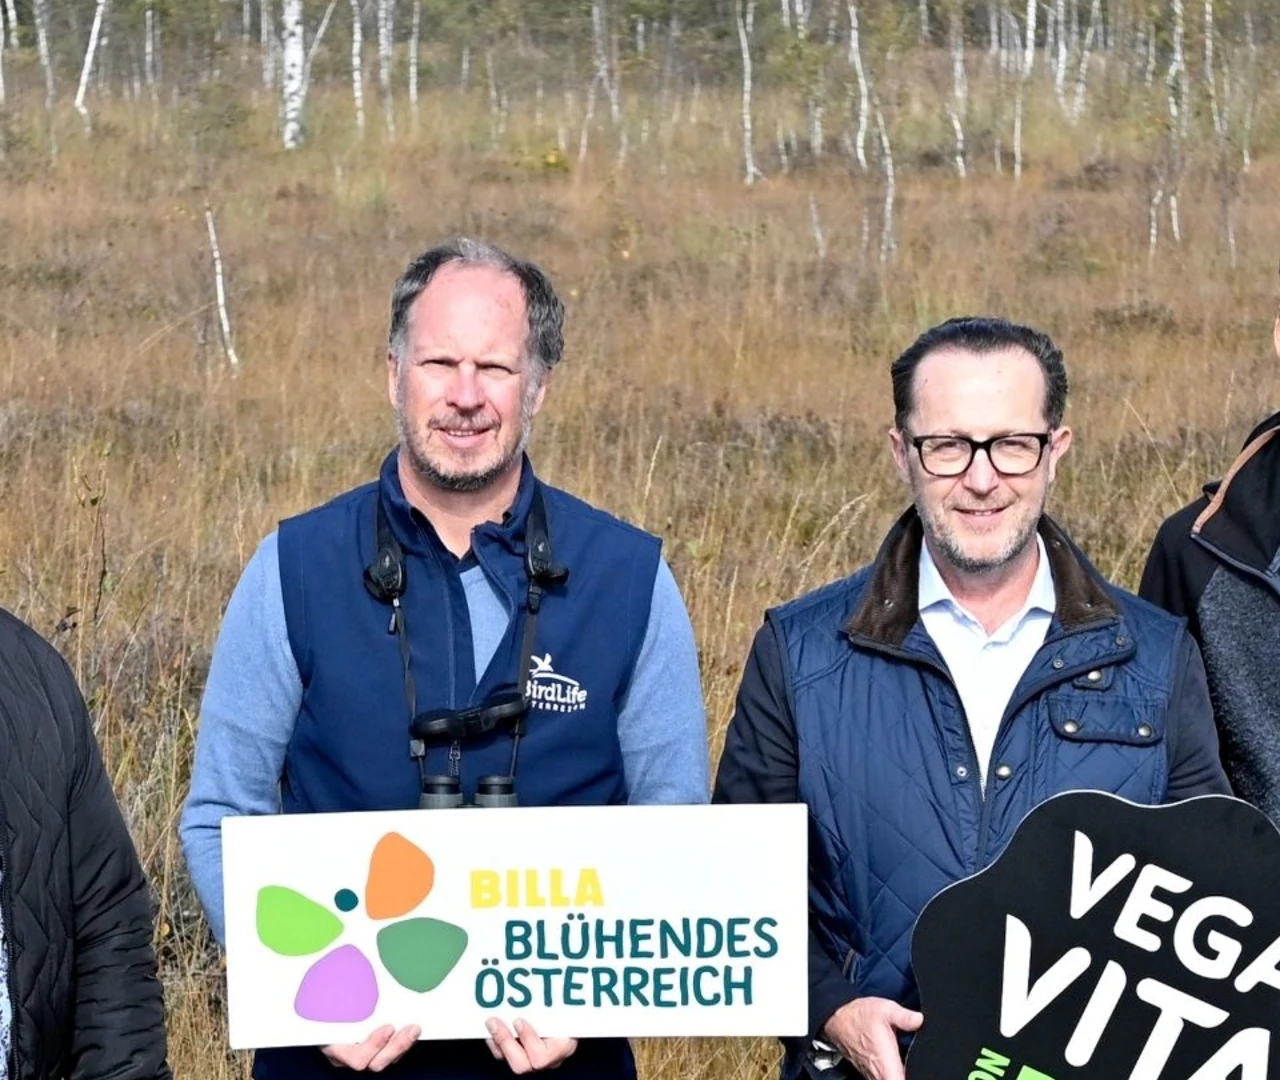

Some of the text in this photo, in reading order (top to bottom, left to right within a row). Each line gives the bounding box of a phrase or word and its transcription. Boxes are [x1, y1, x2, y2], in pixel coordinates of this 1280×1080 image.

[469, 867, 605, 909] BILLA
[505, 913, 779, 960] BLÜHENDES
[475, 958, 753, 1008] ÖSTERREICH
